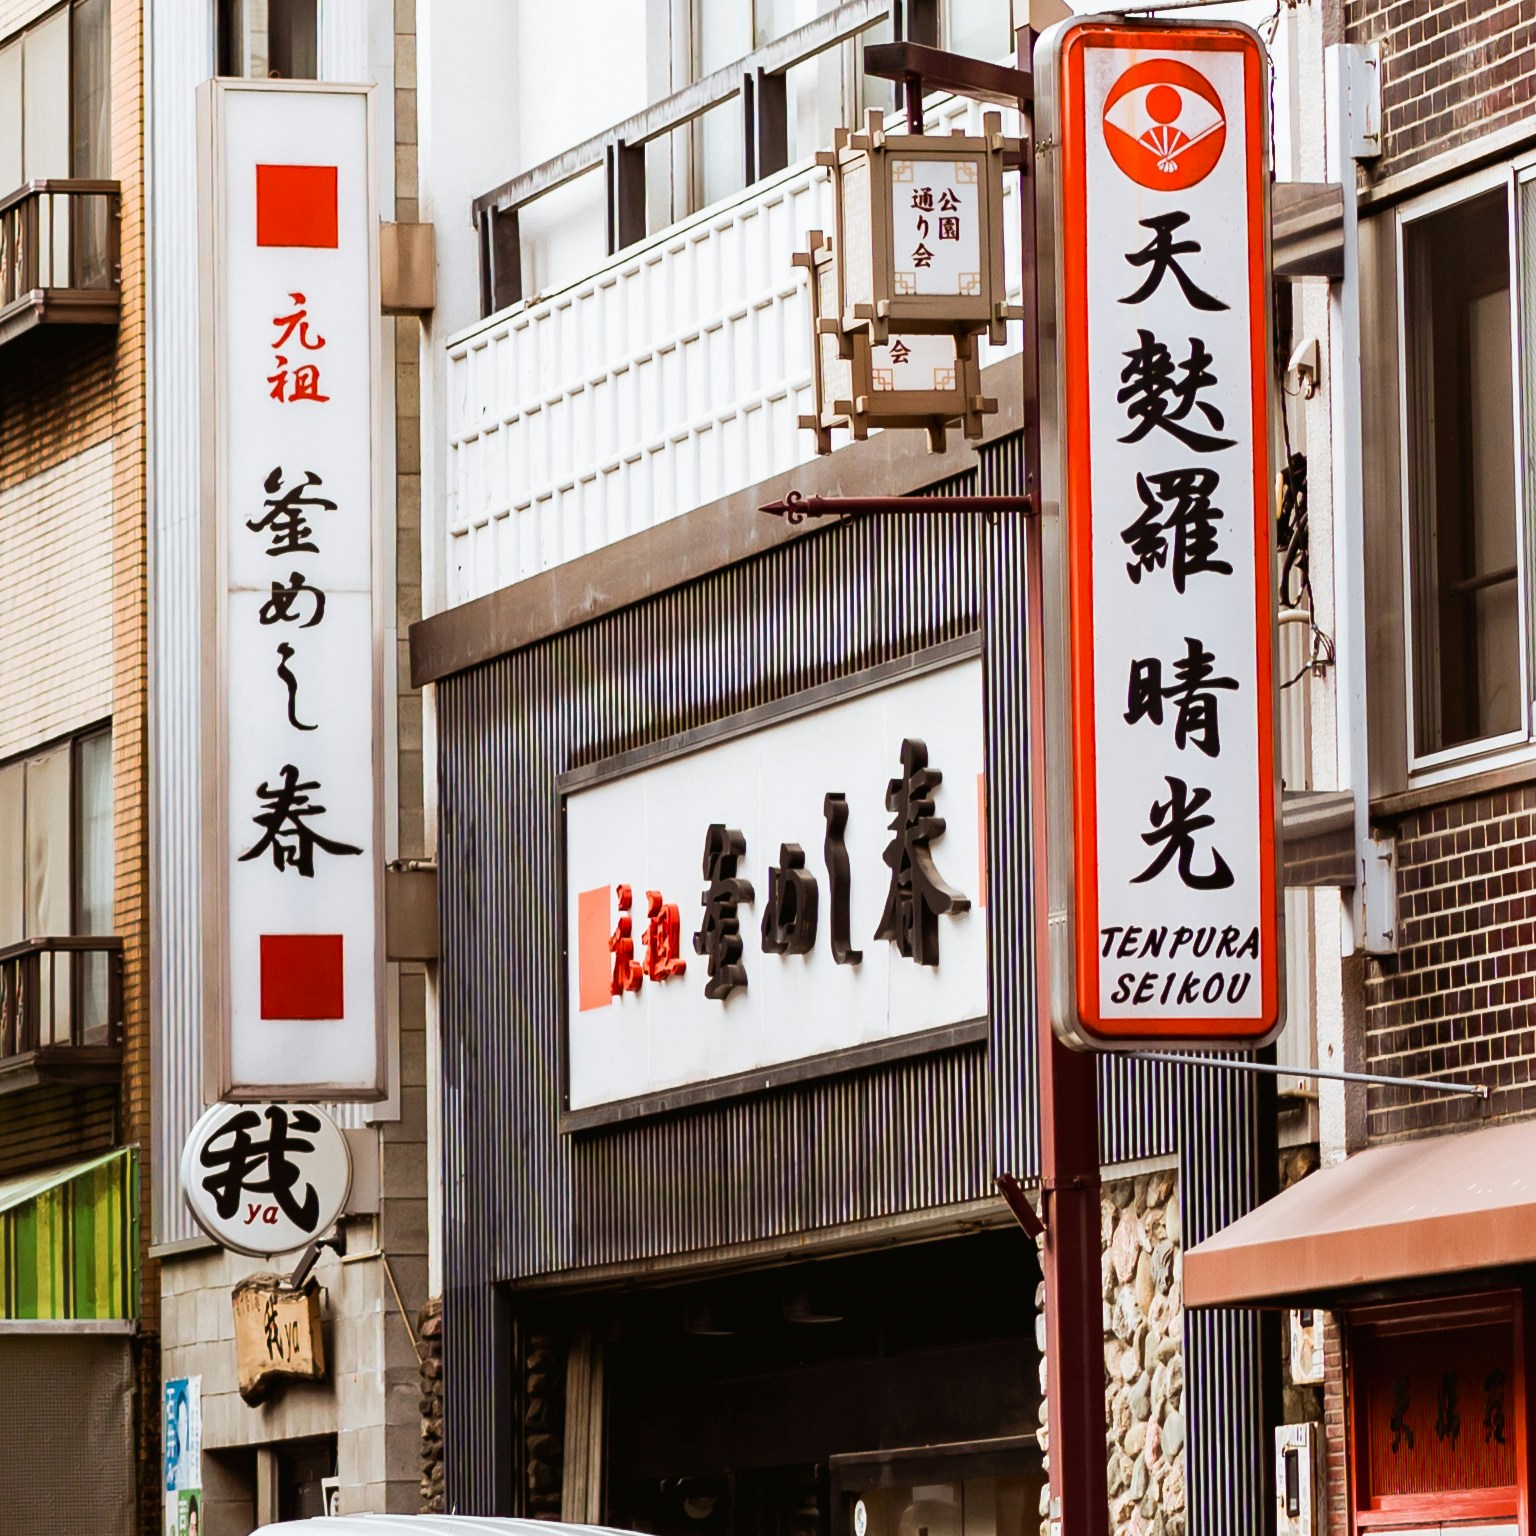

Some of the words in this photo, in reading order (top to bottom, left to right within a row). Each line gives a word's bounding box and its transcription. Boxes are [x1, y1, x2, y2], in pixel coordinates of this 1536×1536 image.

[911, 187, 935, 269] 通り会
[937, 187, 961, 242] 公園
[266, 291, 331, 405] 元祖
[609, 882, 688, 997] 元祖
[1100, 924, 1260, 960] TENPURA
[1110, 970, 1252, 1005] SEIKOU
[244, 1203, 279, 1226] ya
[284, 1320, 300, 1363] ya
